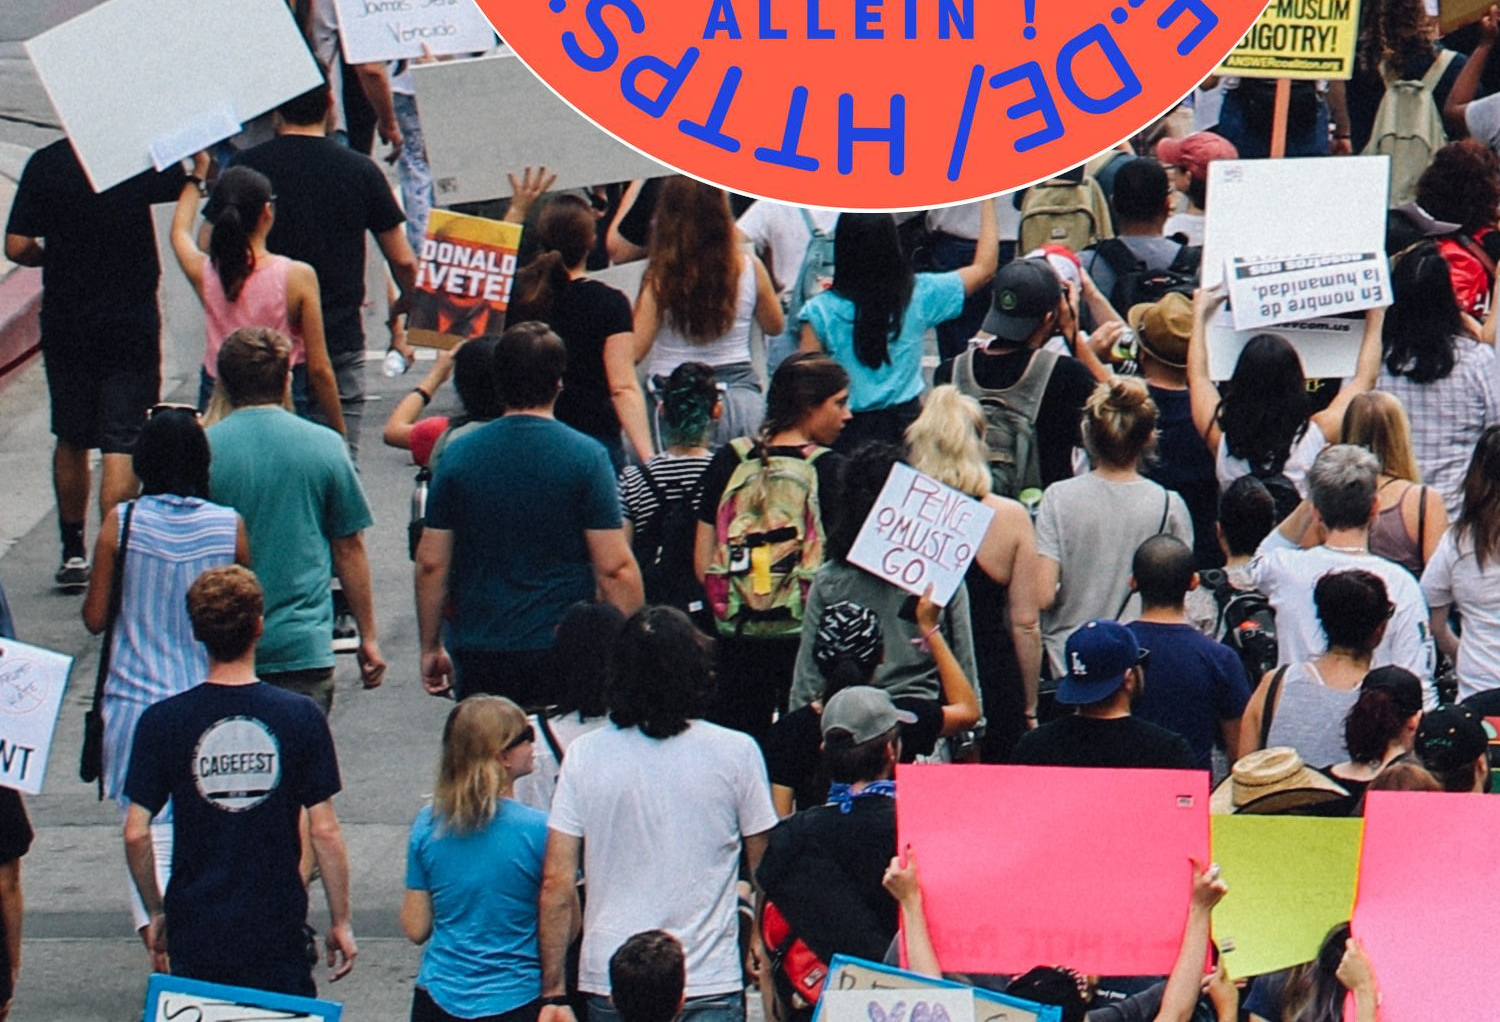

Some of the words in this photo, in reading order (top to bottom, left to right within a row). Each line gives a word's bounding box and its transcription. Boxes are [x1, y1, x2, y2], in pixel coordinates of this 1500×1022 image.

[1235, 14, 1337, 52] BIGOTRY!
[1228, 56, 1341, 72] ANSWERcoalition.org
[422, 239, 517, 273] DONALD
[416, 266, 512, 303] ¡VETE!
[907, 472, 972, 530] PENCE
[892, 522, 955, 565] MUST
[882, 547, 924, 585] GO
[201, 751, 276, 778] CAGEFEST
